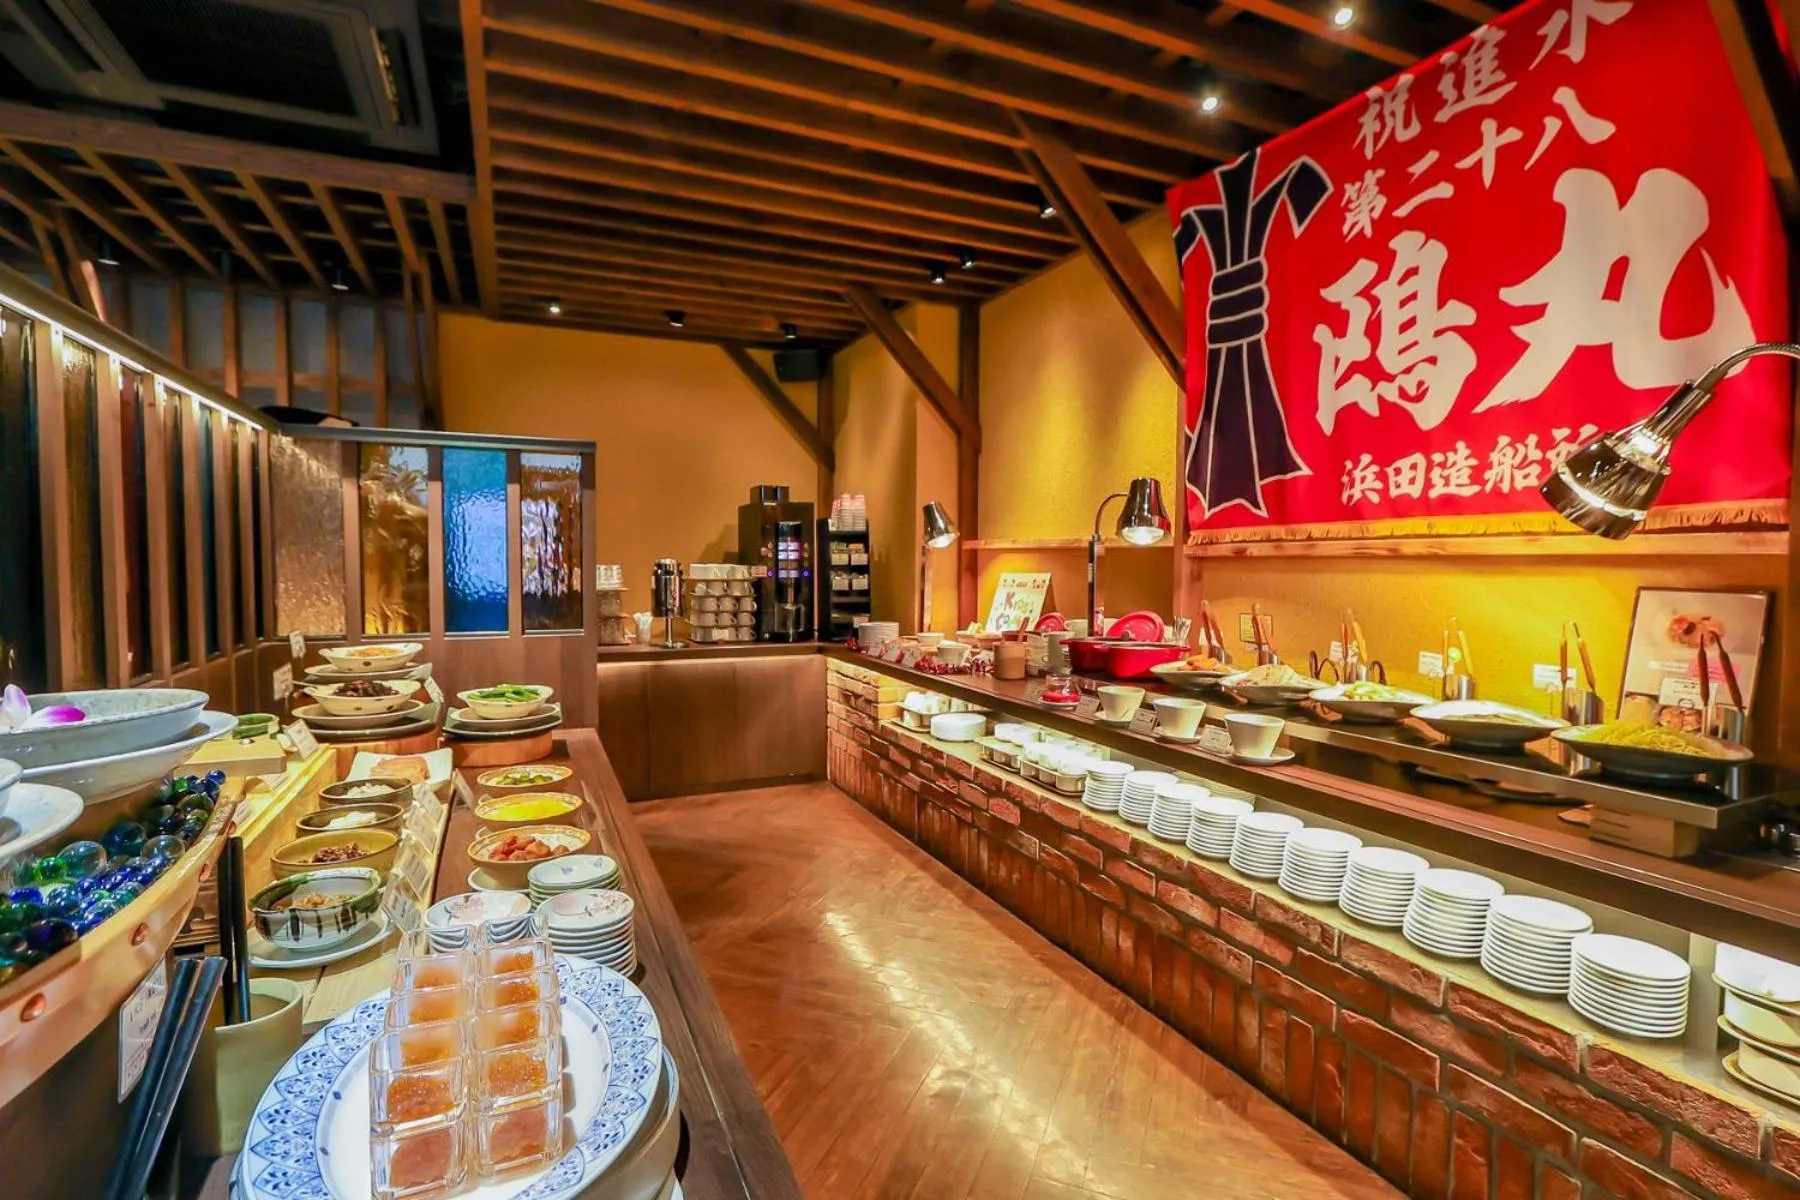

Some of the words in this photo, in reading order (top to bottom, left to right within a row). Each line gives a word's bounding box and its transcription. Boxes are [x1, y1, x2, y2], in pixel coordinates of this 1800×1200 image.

[1353, 0, 1632, 160] 祝進水
[1340, 86, 1617, 242] 第二十八
